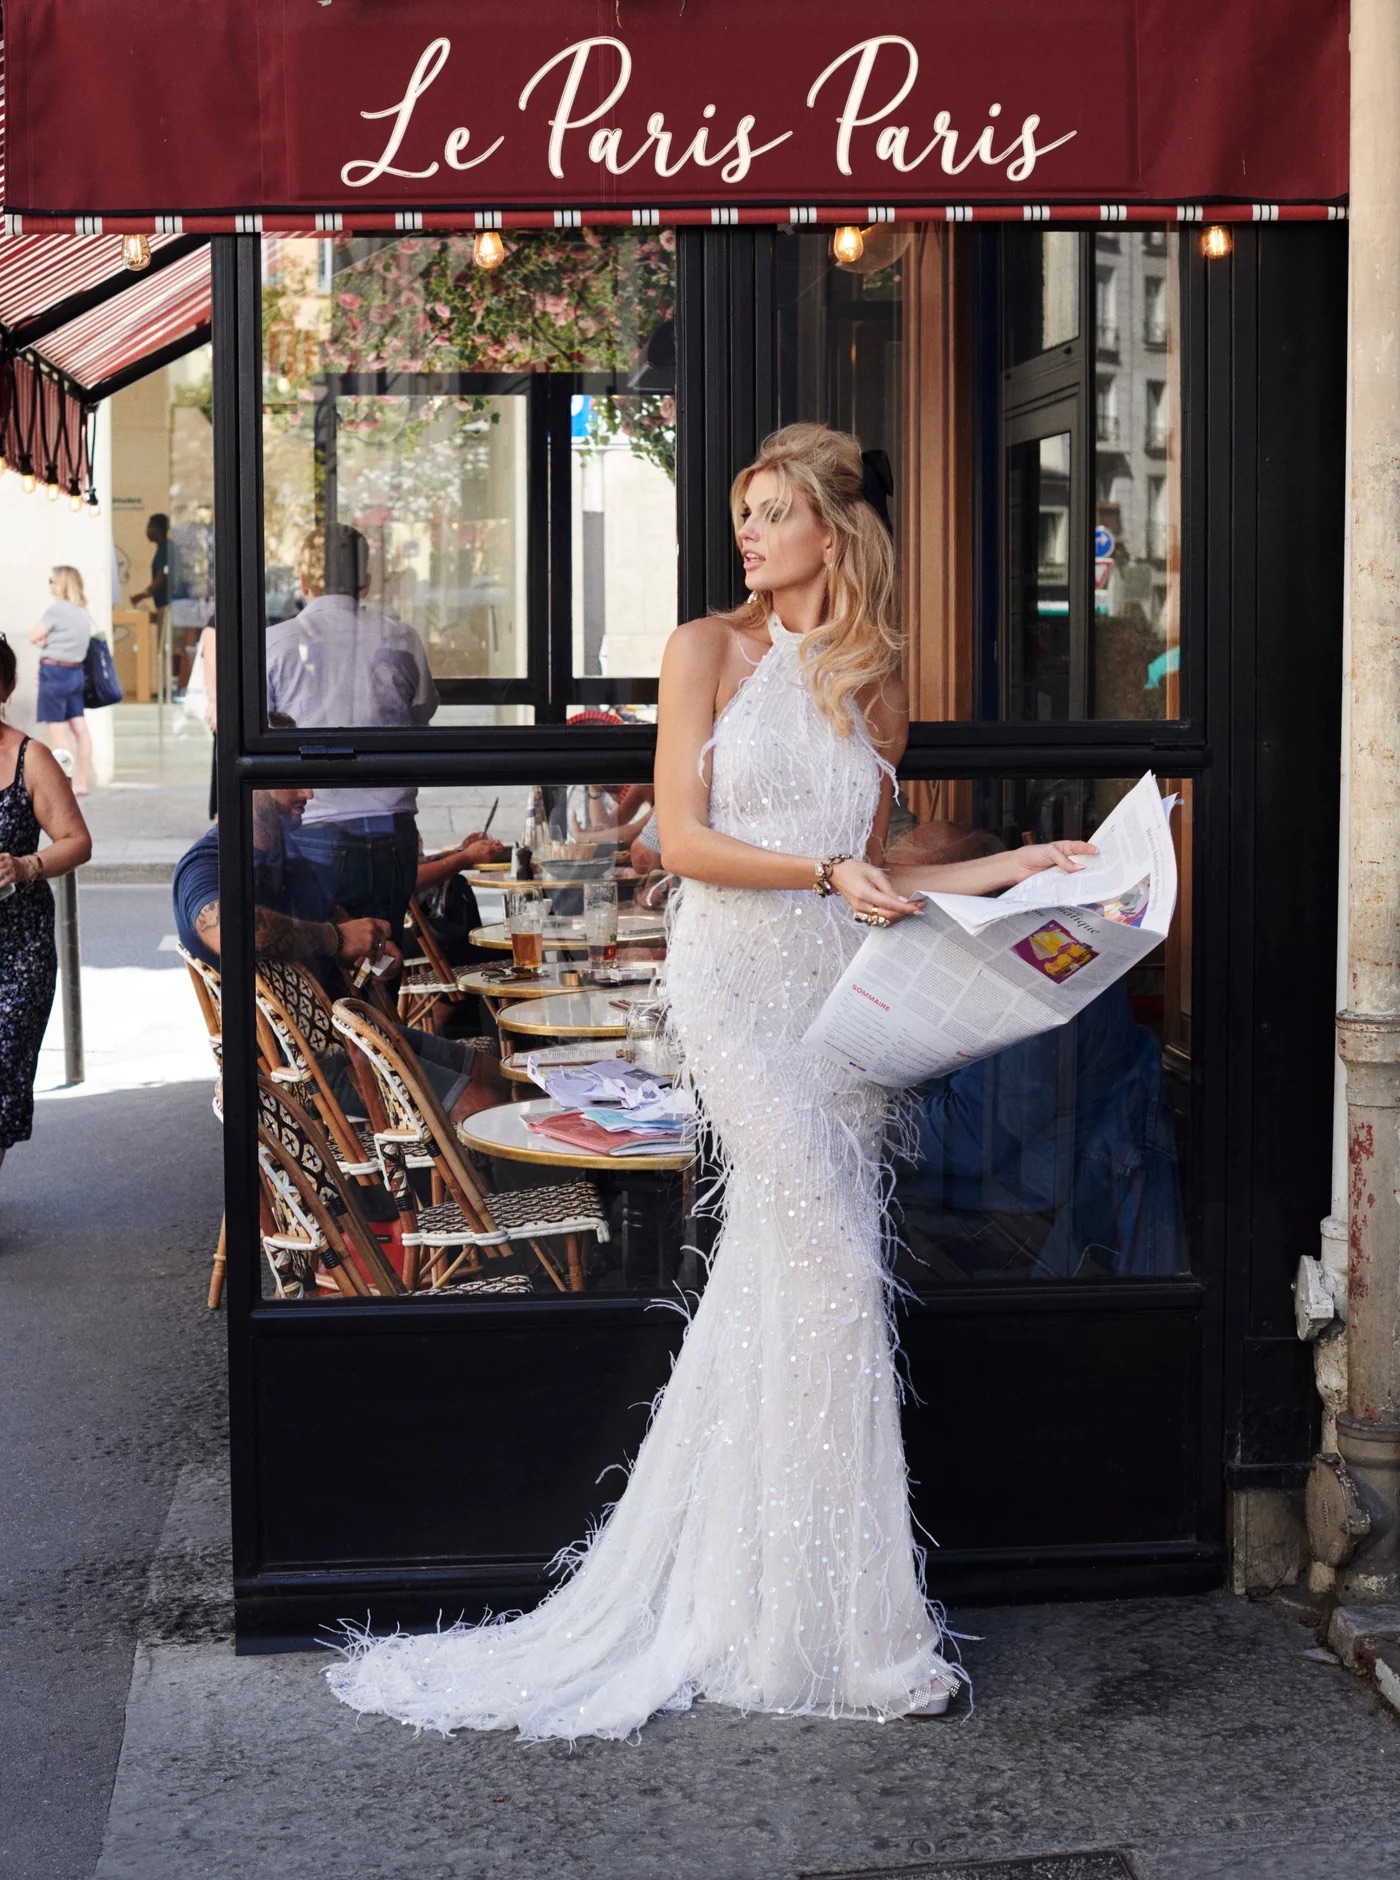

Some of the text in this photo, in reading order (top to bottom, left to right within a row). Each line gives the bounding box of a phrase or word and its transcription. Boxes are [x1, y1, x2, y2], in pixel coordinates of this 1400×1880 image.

[340, 34, 1078, 188] Le Paris Paris
[851, 984, 891, 1012] SOMMAIRE
